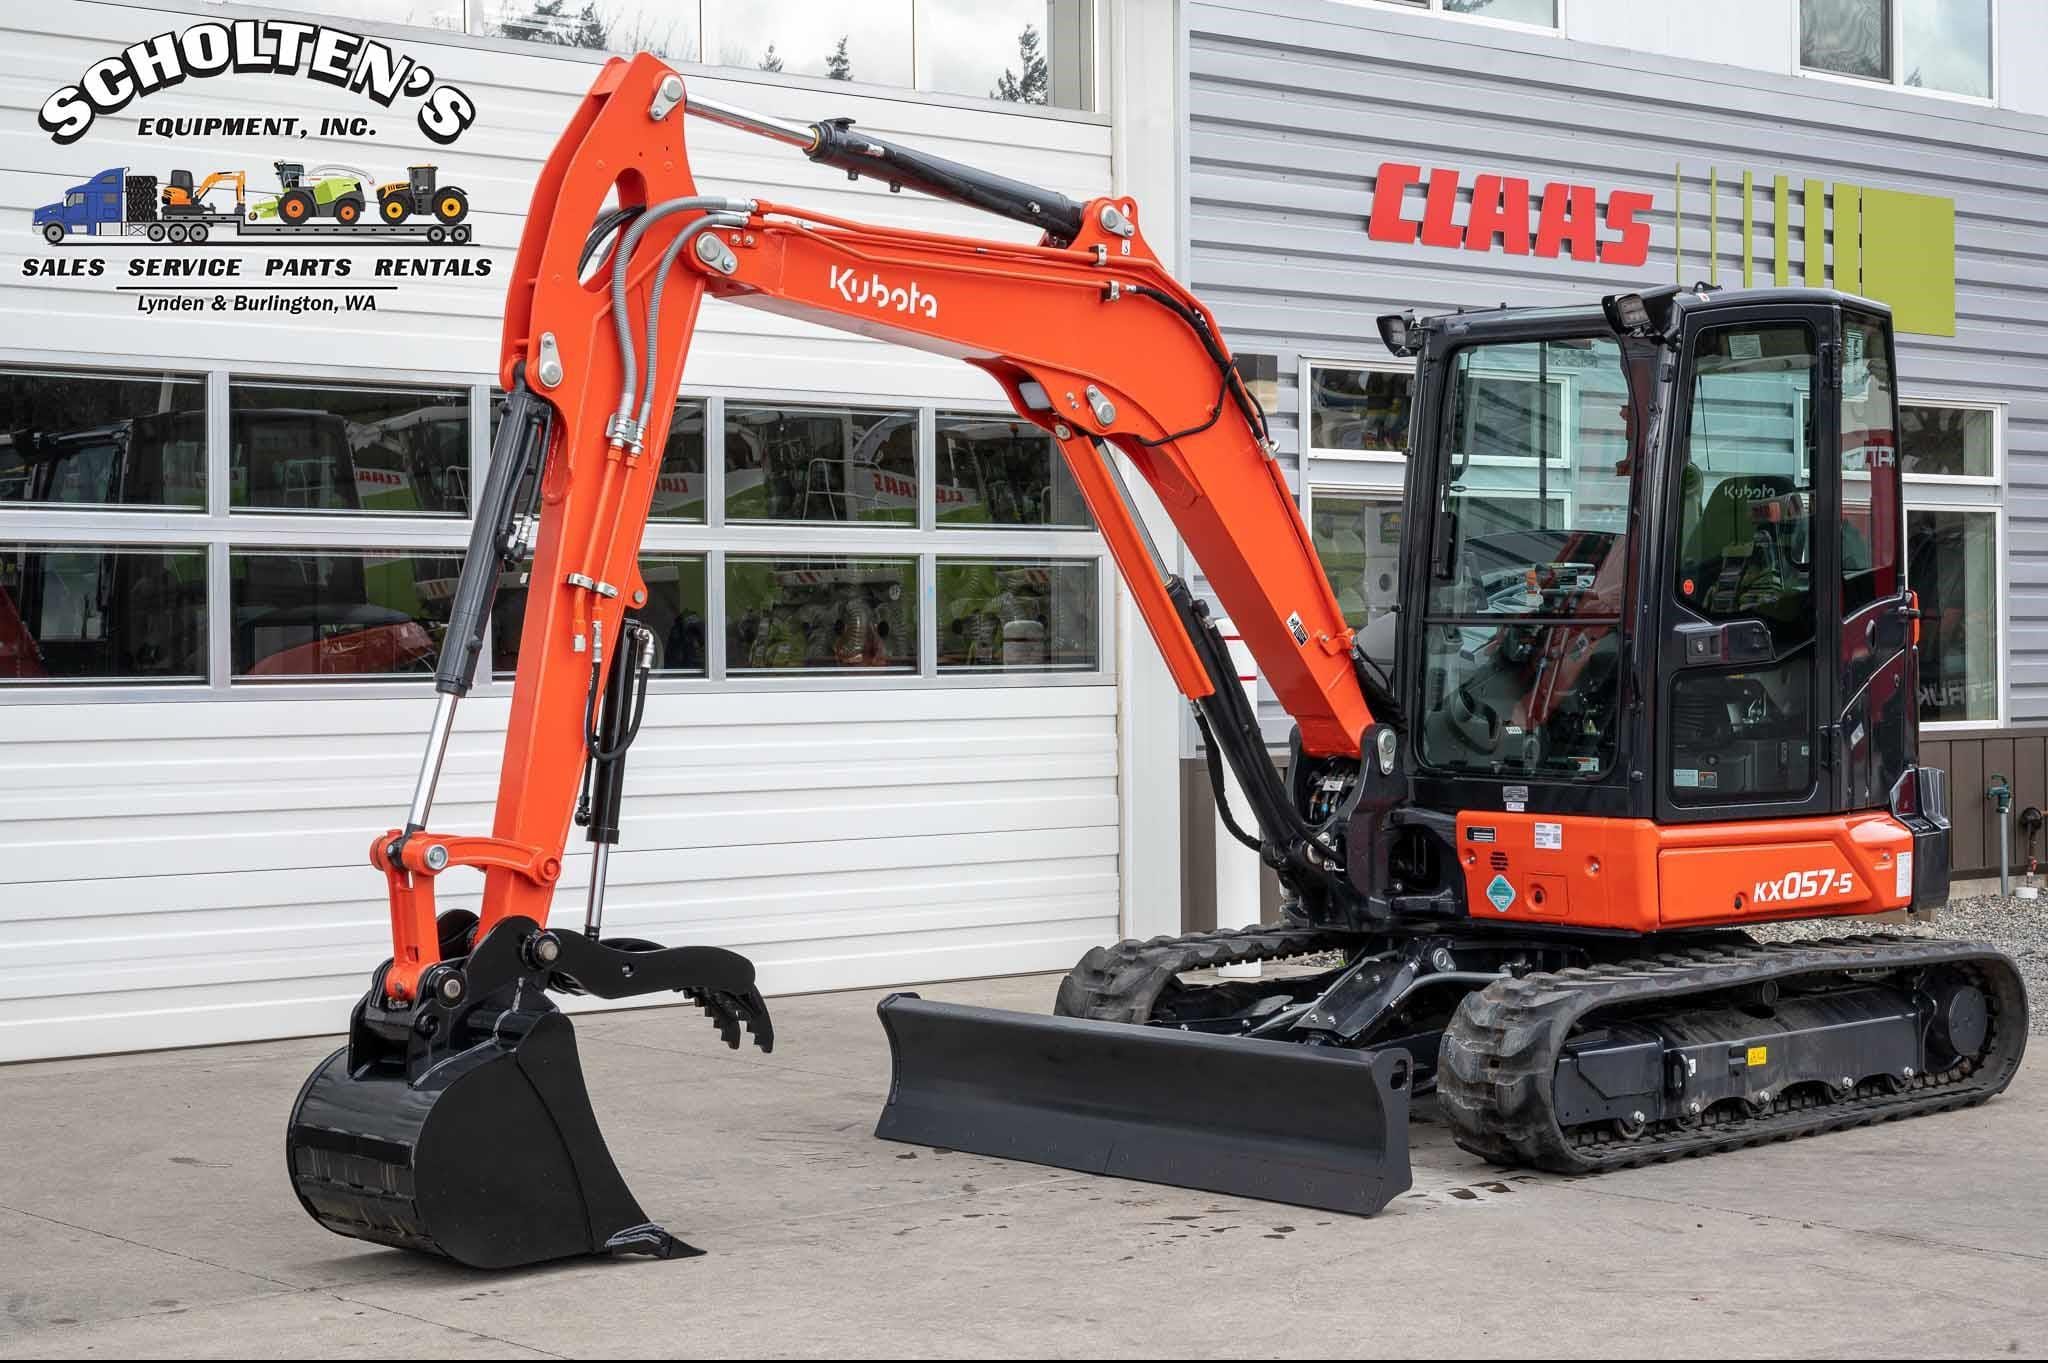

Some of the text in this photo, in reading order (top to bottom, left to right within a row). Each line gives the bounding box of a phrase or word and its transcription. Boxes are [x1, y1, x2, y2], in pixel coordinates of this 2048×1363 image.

[1368, 163, 1653, 266] CLAAS
[829, 264, 938, 318] Kubota
[1724, 483, 1776, 499] Kubota
[1753, 868, 1853, 903] KX057-5
